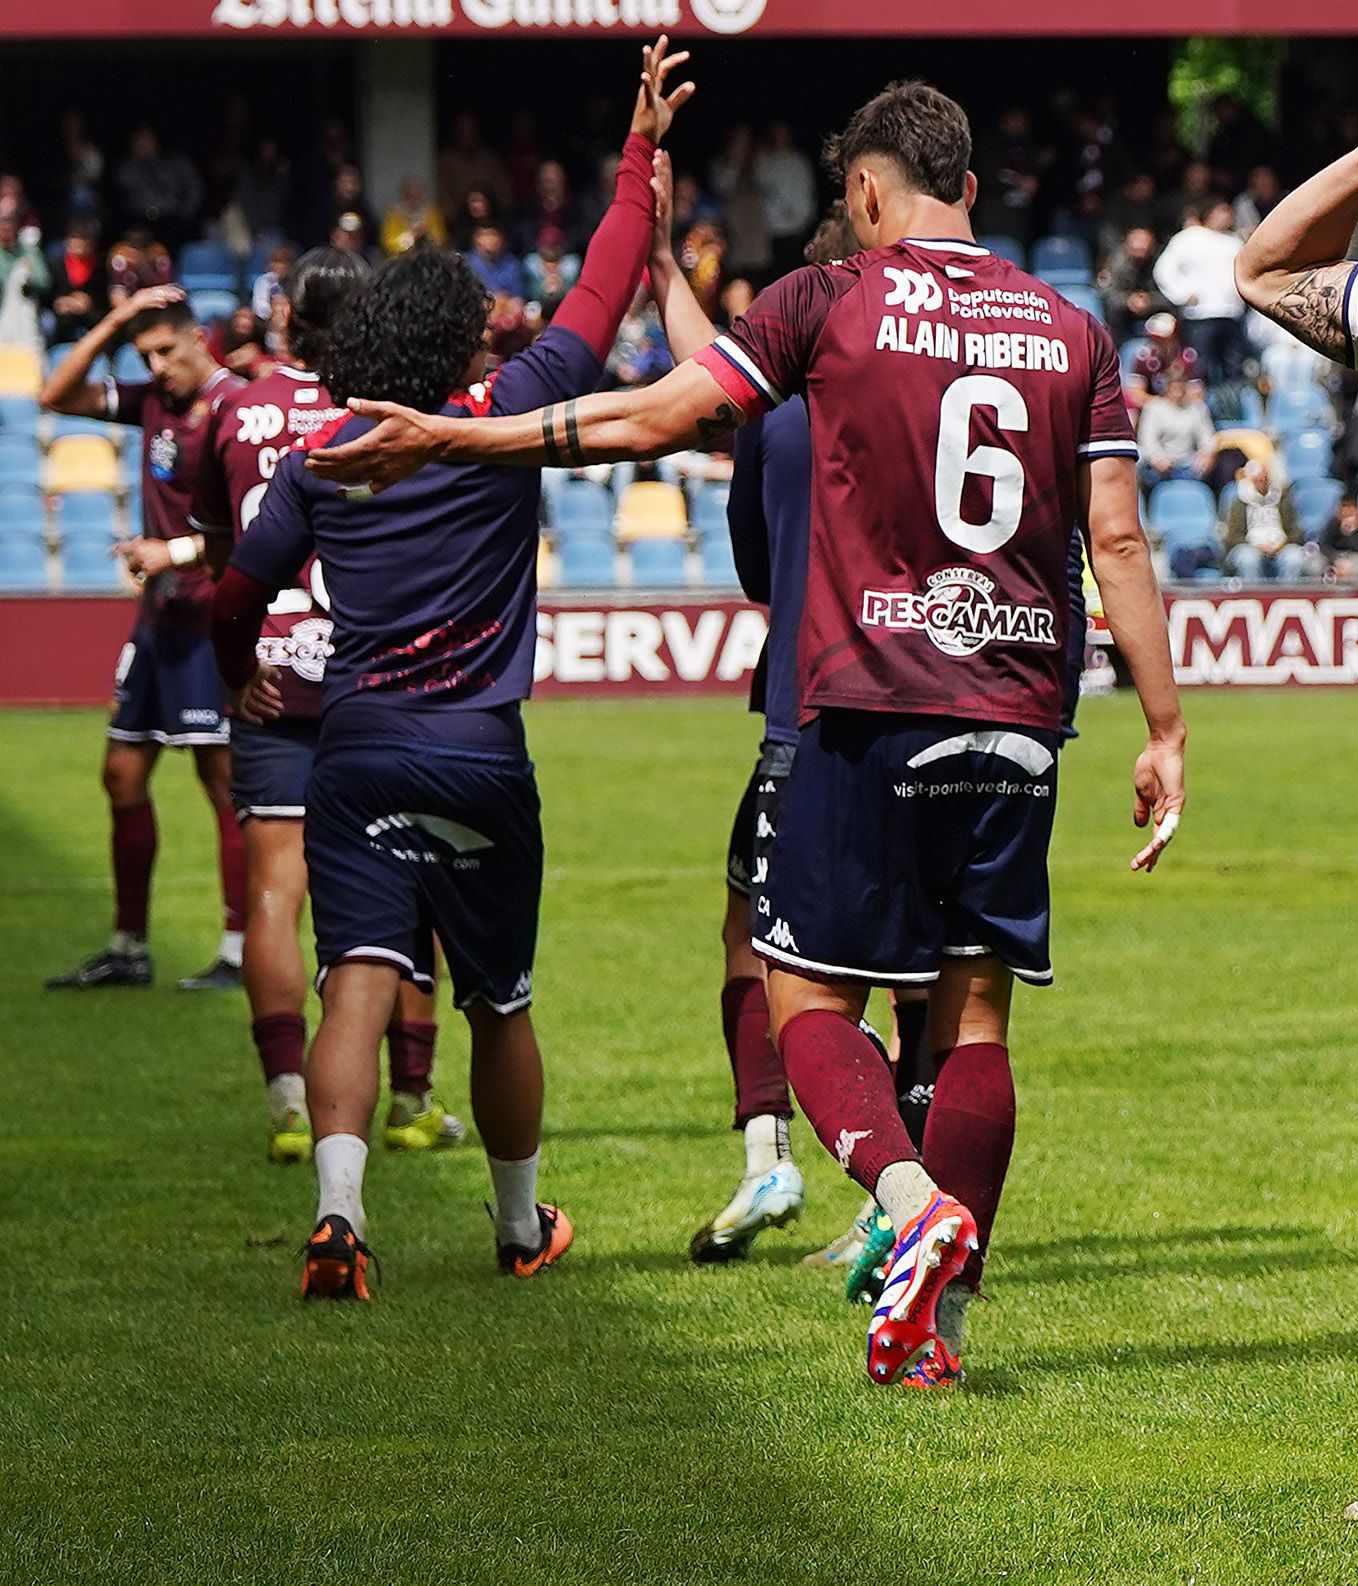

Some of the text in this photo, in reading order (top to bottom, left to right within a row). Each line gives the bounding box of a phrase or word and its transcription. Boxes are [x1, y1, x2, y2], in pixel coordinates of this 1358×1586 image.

[949, 306, 1053, 325] Pontevedra
[875, 315, 1070, 374] ALAIN RIBEIRO
[934, 374, 1029, 555] 6
[926, 567, 996, 594] CONSERVAS
[861, 589, 1057, 645] PESCAMAR
